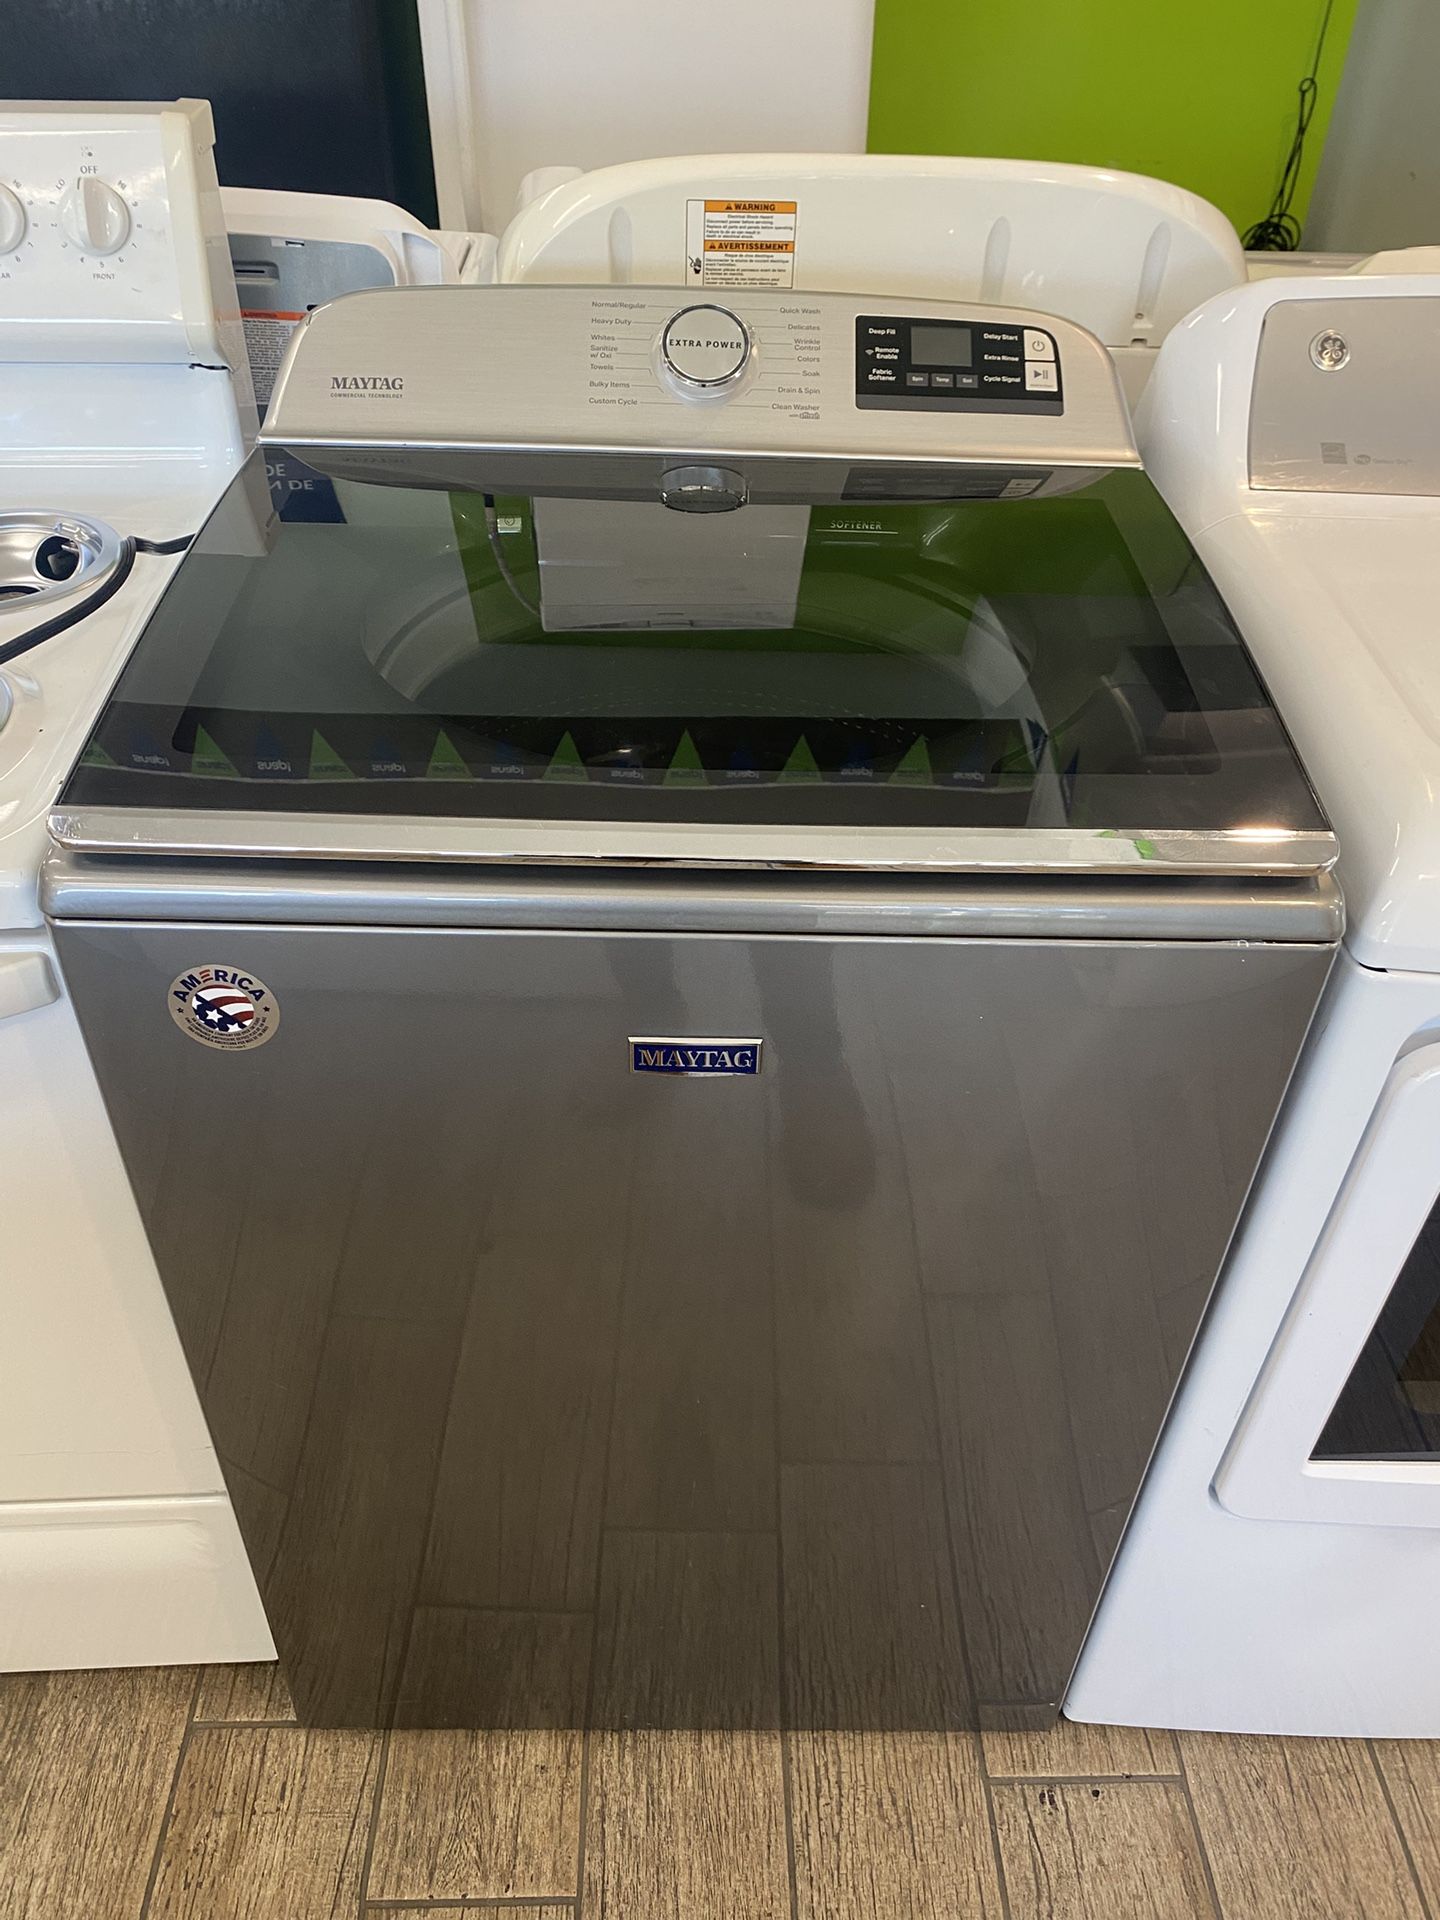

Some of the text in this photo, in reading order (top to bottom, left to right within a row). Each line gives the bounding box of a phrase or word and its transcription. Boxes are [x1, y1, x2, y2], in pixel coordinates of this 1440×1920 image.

[80, 165, 99, 174] OFF
[55, 178, 66, 191] LO
[735, 203, 776, 211] WARNING
[718, 242, 789, 250] AVERTISSEMENT
[591, 301, 647, 310] Normal/Regular
[983, 333, 1001, 341] Delay
[669, 339, 742, 350] EXTRA POWER
[330, 377, 404, 390] MAYTAG
[1002, 376, 1021, 384] Signal
[617, 398, 638, 406] Cycle
[830, 520, 882, 530] SOFTENER
[173, 969, 266, 1003] AMERICA
[639, 1049, 752, 1068] MAYTAG
